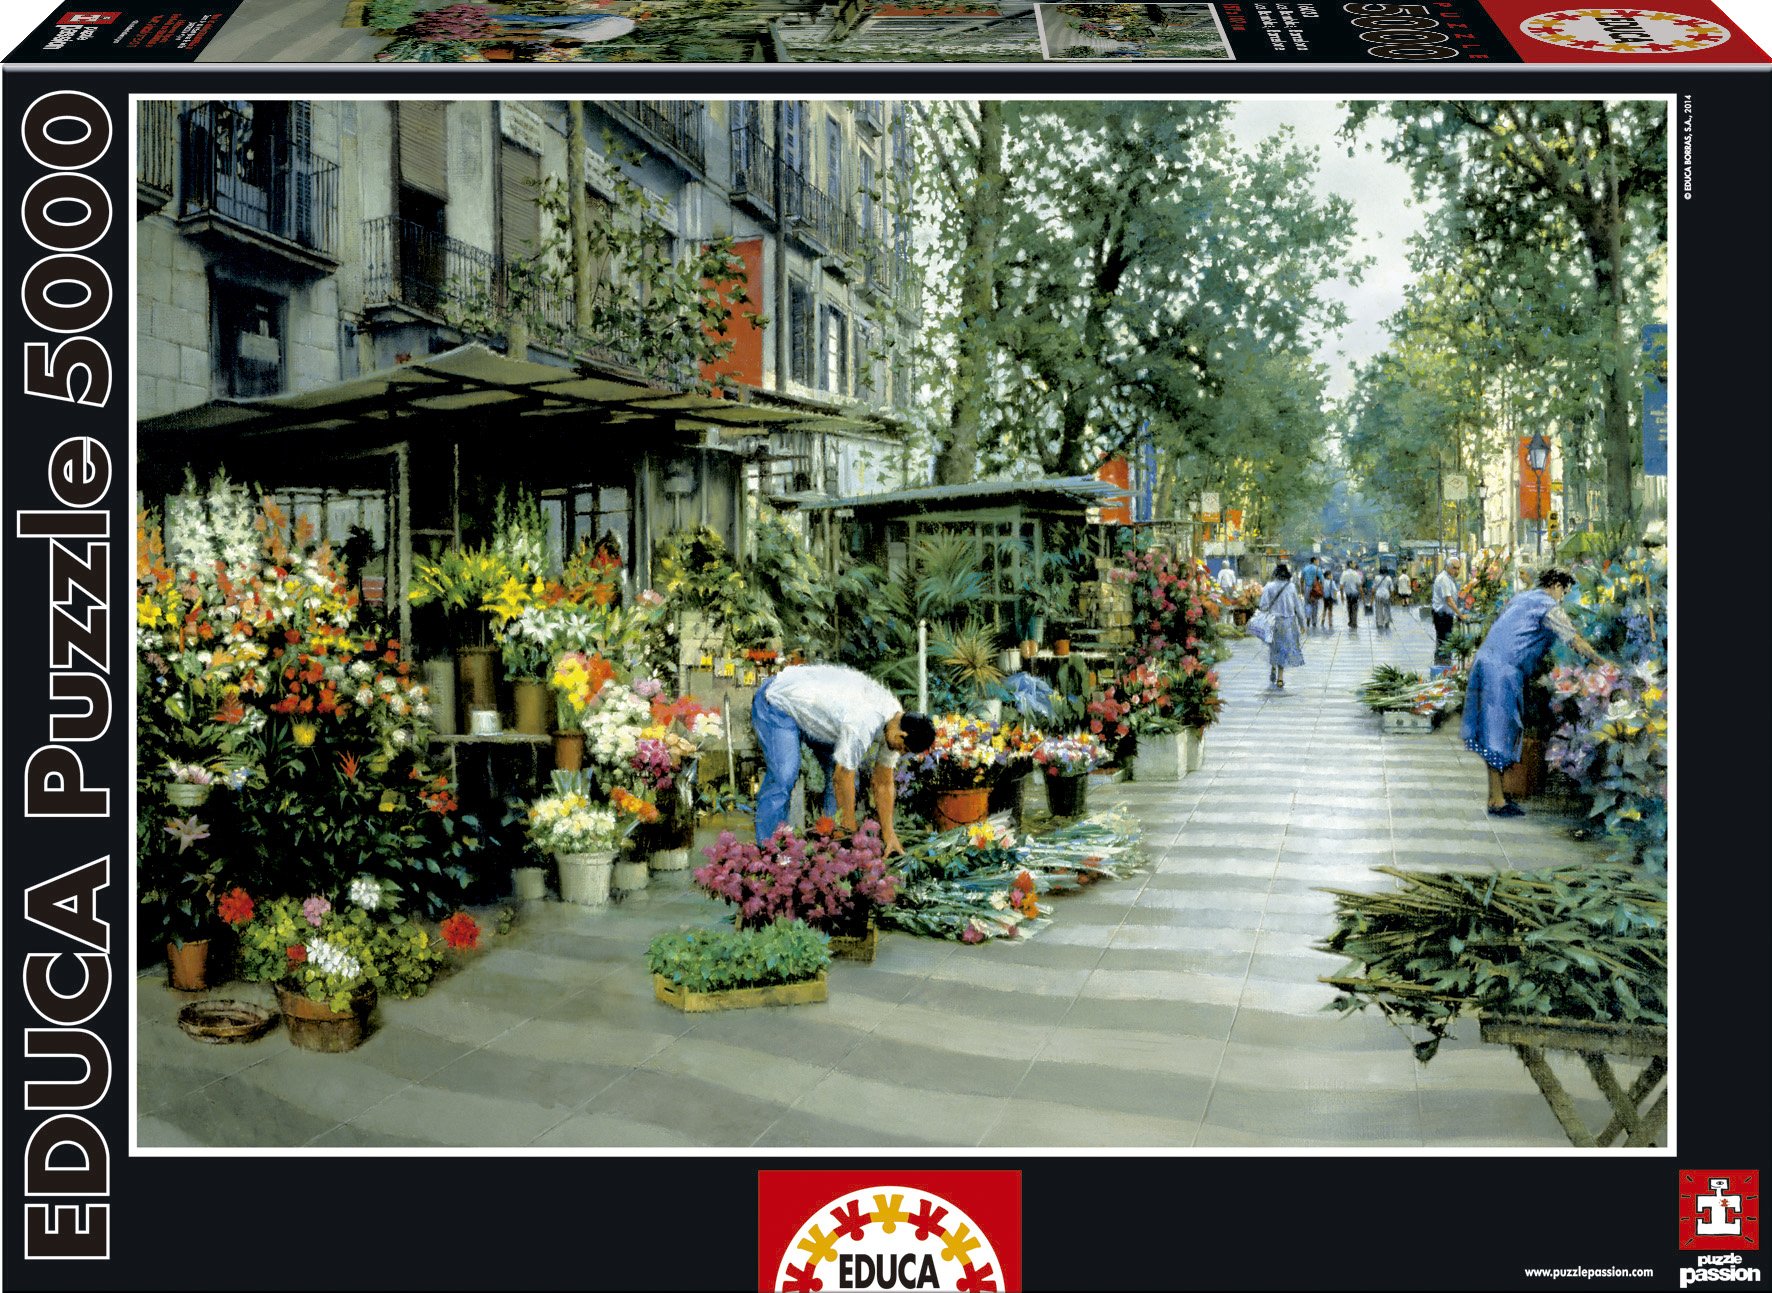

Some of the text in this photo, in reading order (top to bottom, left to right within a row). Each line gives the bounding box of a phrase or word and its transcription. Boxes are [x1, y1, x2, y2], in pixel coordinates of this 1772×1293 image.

[42, 24, 84, 50] passion
[1342, 2, 1460, 60] 5000
[1433, 2, 1489, 59] PUZZLE
[1594, 17, 1655, 44] EDUCA
[1684, 94, 1692, 114] 2014
[1684, 115, 1693, 133] S.A.,
[1684, 133, 1693, 166] BORRAS,
[1684, 166, 1692, 192] EDUCA
[16, 89, 113, 1261] EDUCA Puzzle 5000
[838, 1253, 941, 1290] EDUCA
[1524, 1265, 1654, 1280] www.puzzlepassion.com
[1697, 1253, 1743, 1266] puzzle
[1679, 1264, 1761, 1289] passion
